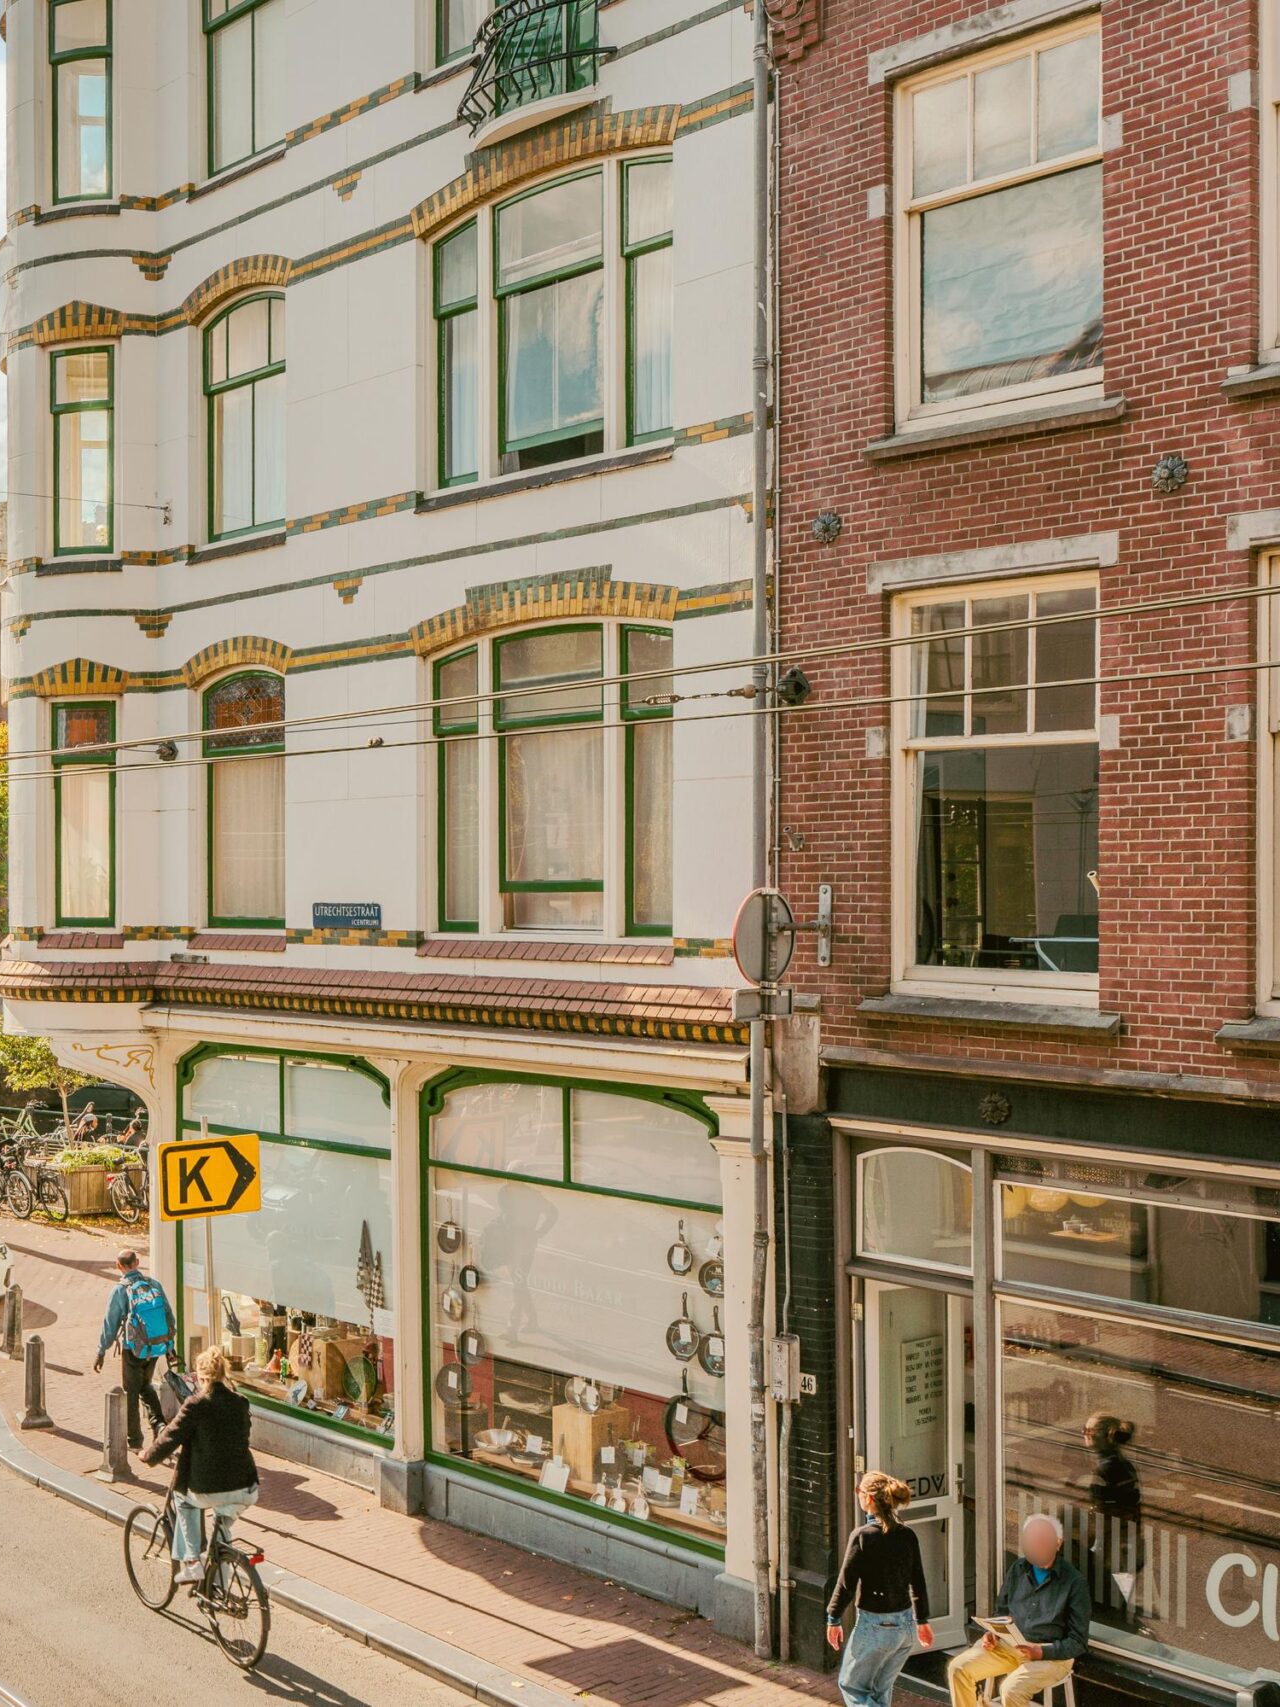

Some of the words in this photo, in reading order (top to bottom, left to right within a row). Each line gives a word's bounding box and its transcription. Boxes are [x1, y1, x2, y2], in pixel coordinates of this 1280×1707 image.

[314, 906, 379, 917] UTRECHTSESTRAAT
[179, 1156, 213, 1204] K
[801, 1376, 813, 1391] 46
